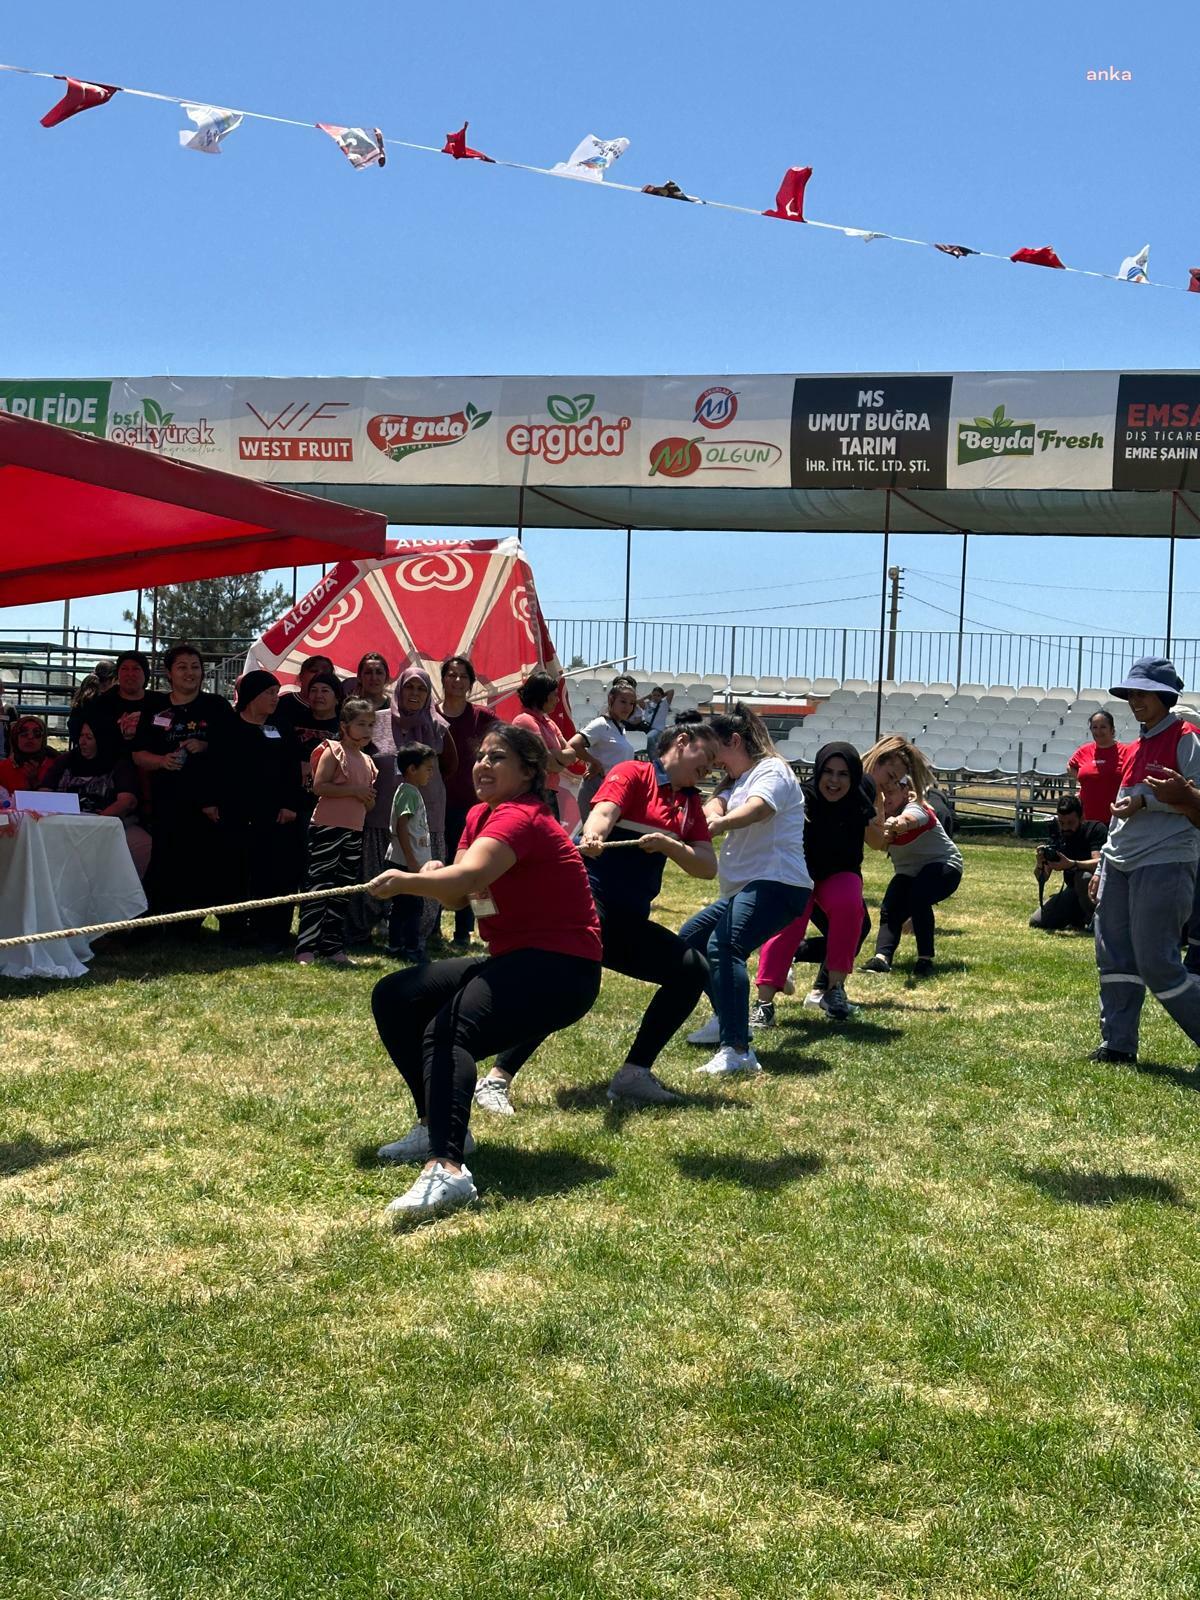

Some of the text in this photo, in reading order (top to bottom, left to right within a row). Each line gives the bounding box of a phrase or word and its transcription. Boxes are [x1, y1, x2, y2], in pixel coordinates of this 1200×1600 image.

[858, 390, 884, 407] MS
[42, 393, 98, 424] FİDE
[379, 417, 408, 442] iyi
[808, 409, 931, 431] UMUT BUĞRA
[839, 436, 897, 455] TARIM
[960, 429, 1104, 454] Beyda Fresh
[1126, 431, 1147, 442] DIŞ
[241, 440, 350, 459] WEST FRUIT
[706, 448, 771, 464] OLGUN
[1125, 447, 1158, 459] EMRE
[806, 458, 828, 472] İHR.
[832, 458, 854, 472] İTH.
[857, 458, 878, 472] TİC.
[882, 460, 906, 472] LTD.
